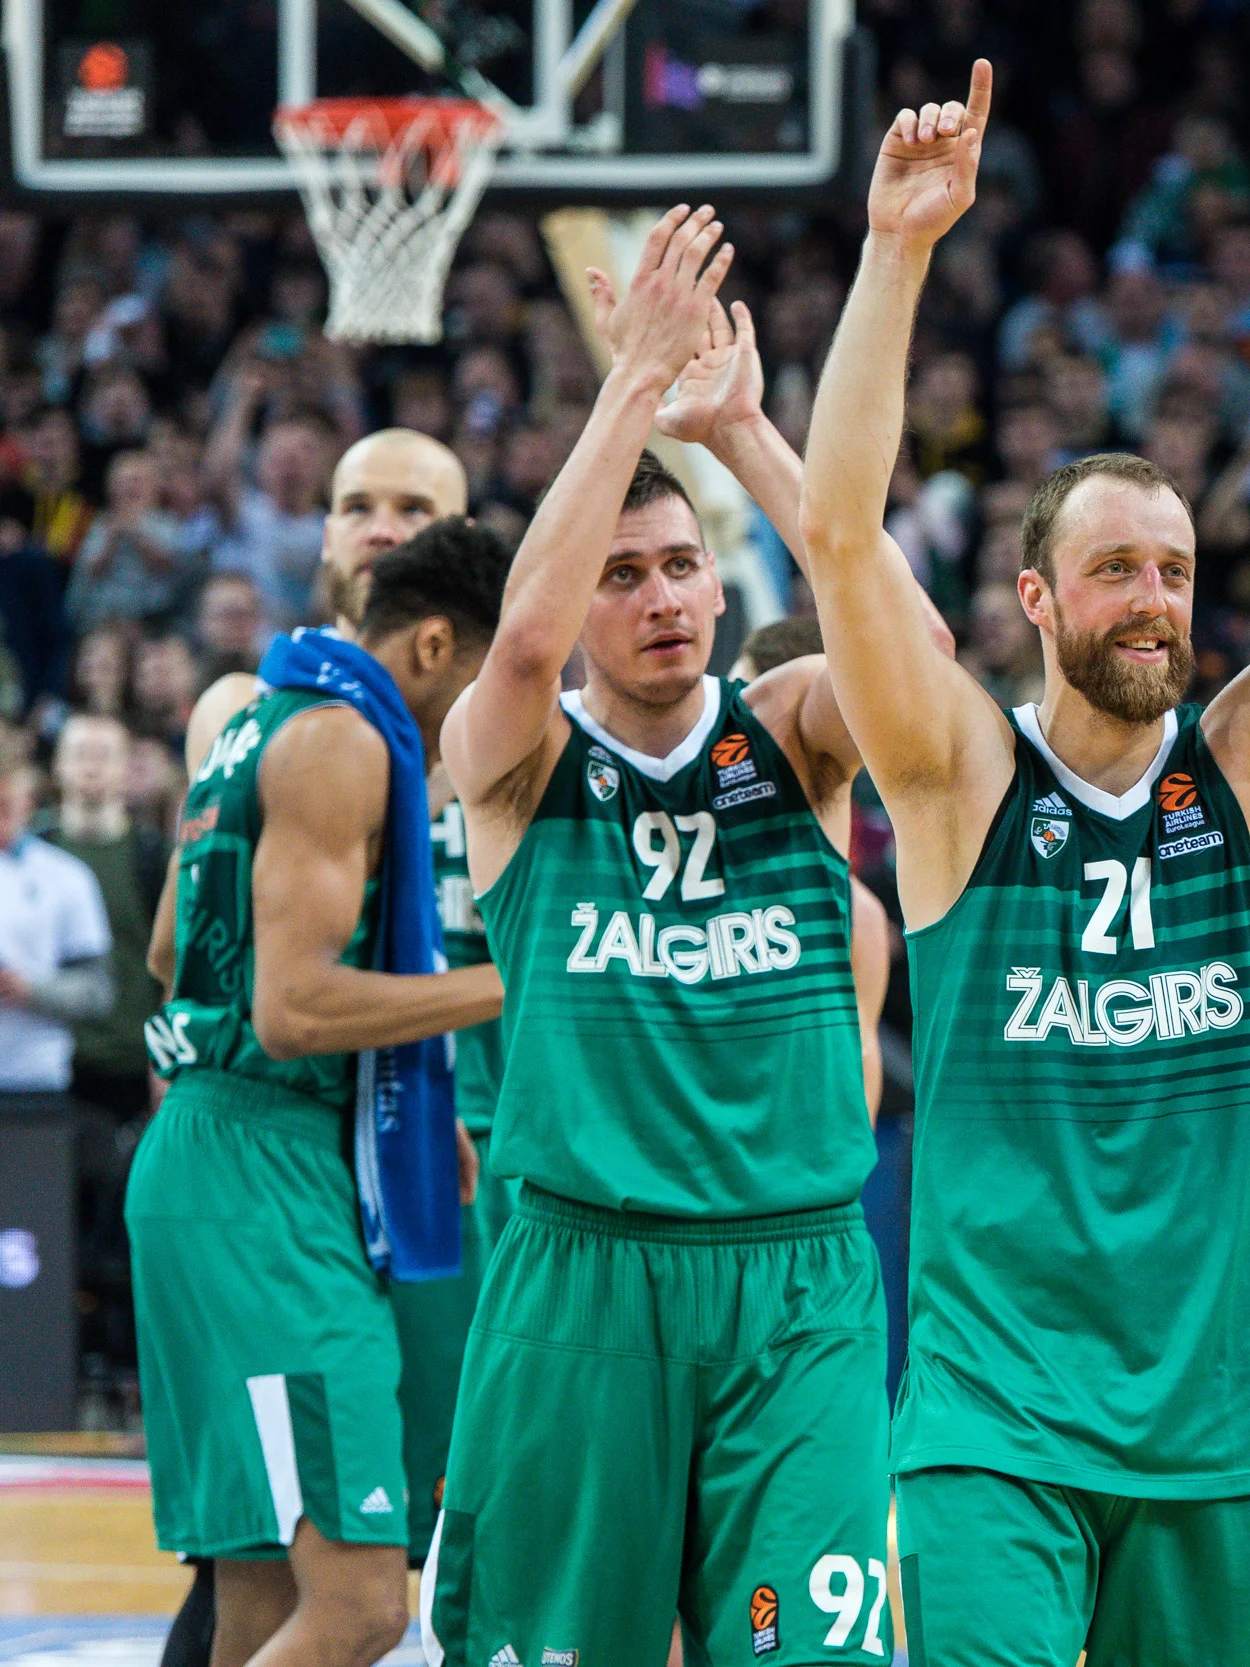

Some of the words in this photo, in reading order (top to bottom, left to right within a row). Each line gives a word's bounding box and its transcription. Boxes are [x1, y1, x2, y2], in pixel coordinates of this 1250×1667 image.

[714, 784, 775, 807] oneteam
[1032, 804, 1073, 817] adidas
[1162, 805, 1202, 821] TURKISH
[1165, 812, 1204, 829] AIRLINES
[632, 811, 725, 901] 92
[1159, 832, 1222, 857] oneteam
[1081, 857, 1155, 955] 21
[566, 902, 802, 984] ŽALGIRIS
[1004, 961, 1244, 1046] ŽALGIRIS
[808, 1554, 887, 1657] 92
